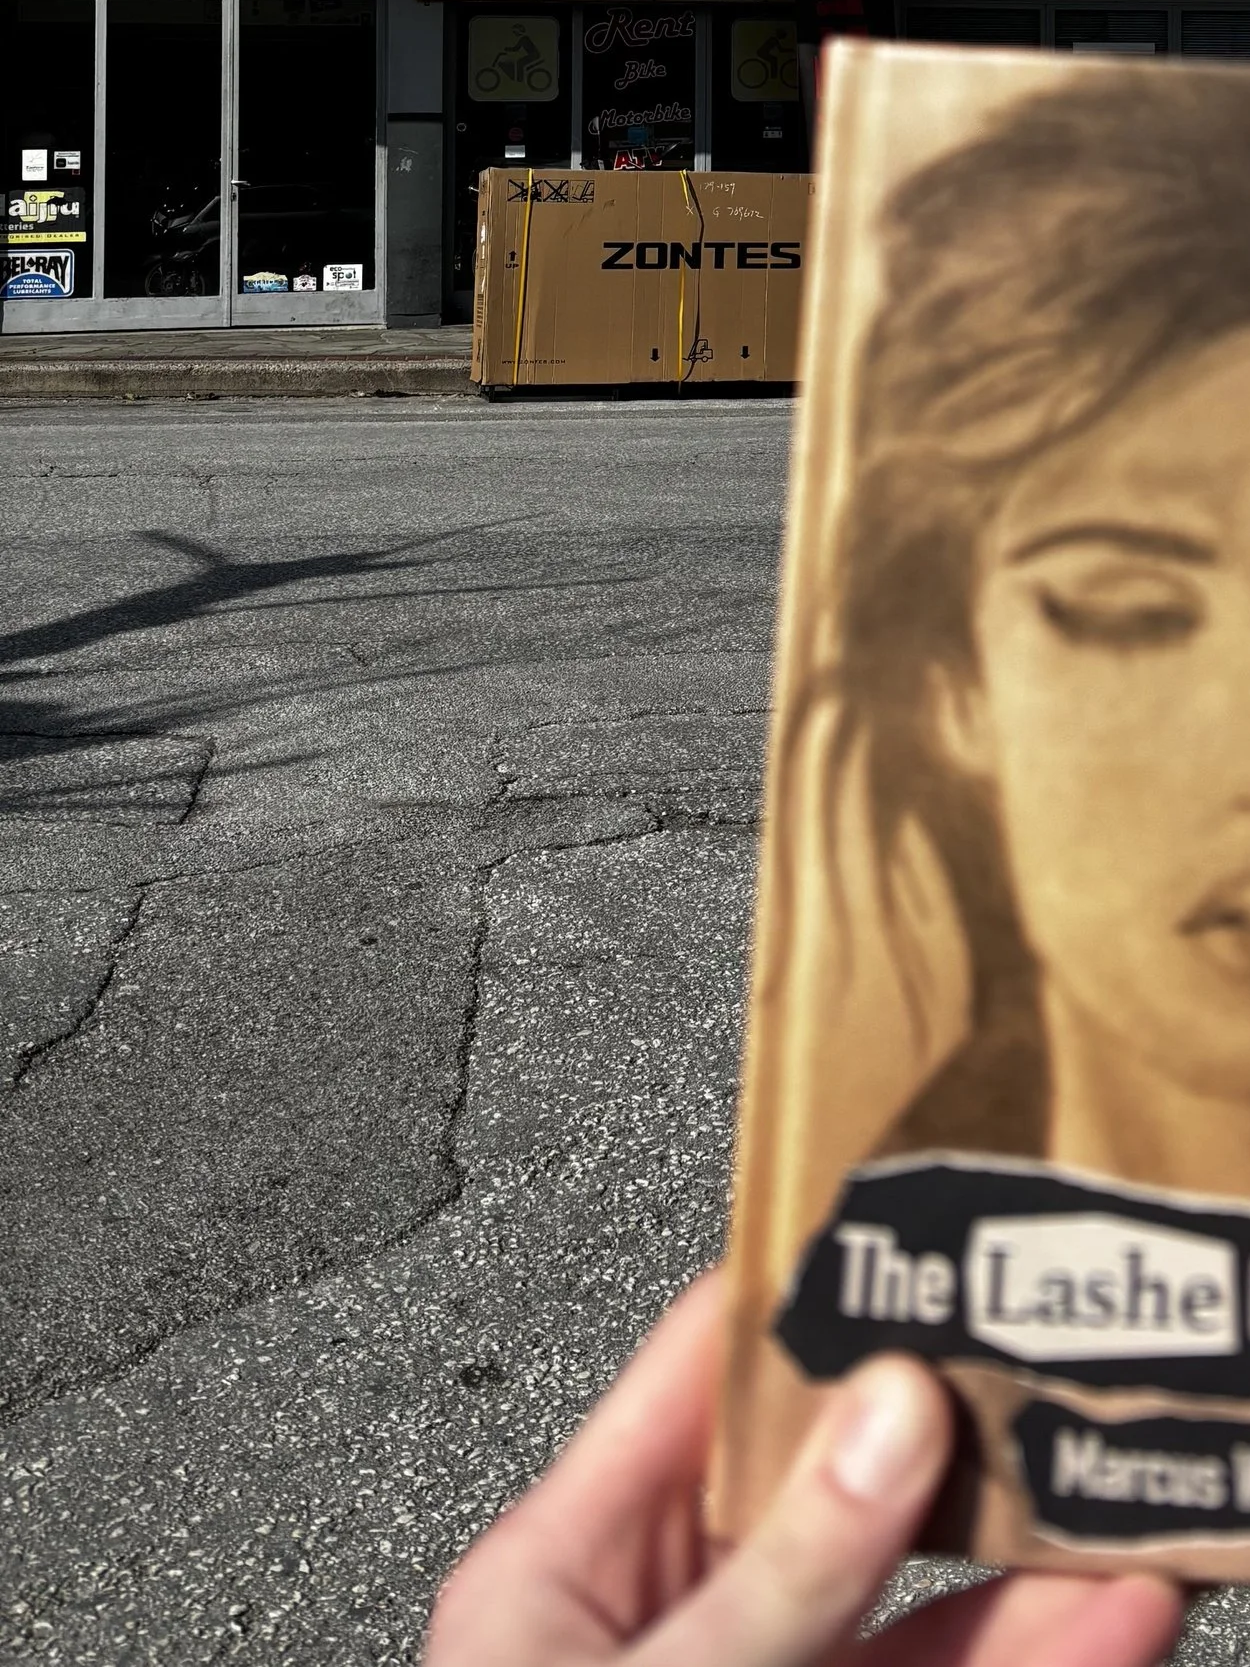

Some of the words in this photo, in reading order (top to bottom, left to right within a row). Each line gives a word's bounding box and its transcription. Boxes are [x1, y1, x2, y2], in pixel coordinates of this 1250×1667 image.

[584, 7, 696, 54] Rent
[614, 58, 667, 91] Bike
[588, 101, 692, 135] Motorbike
[600, 241, 802, 271] ZONTES
[835, 1223, 955, 1324] The
[981, 1242, 1226, 1332] Lashe
[1050, 1427, 1227, 1512] Marcus
